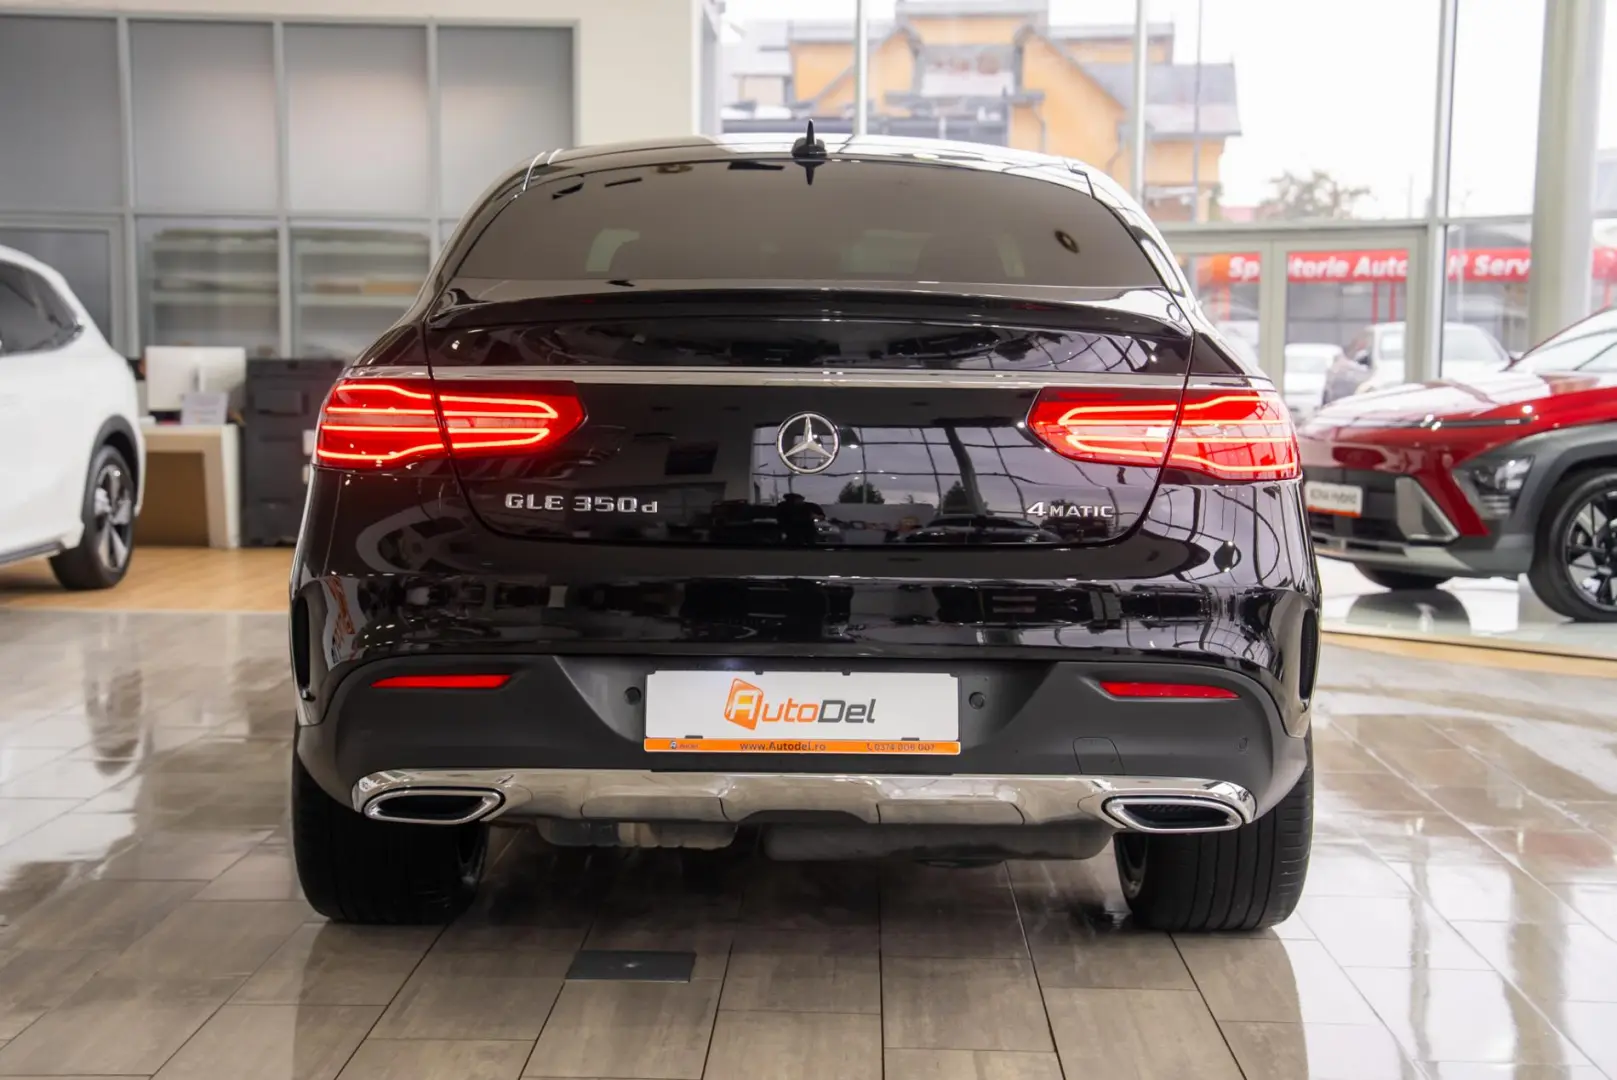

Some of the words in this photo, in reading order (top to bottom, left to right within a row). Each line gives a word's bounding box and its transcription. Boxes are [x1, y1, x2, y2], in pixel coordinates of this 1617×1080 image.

[505, 493, 564, 511] GLE
[573, 496, 658, 514] 350d
[1027, 501, 1113, 518] 4MATIC
[724, 679, 877, 730] AutoDel
[739, 741, 826, 752] www.Autodel.ro
